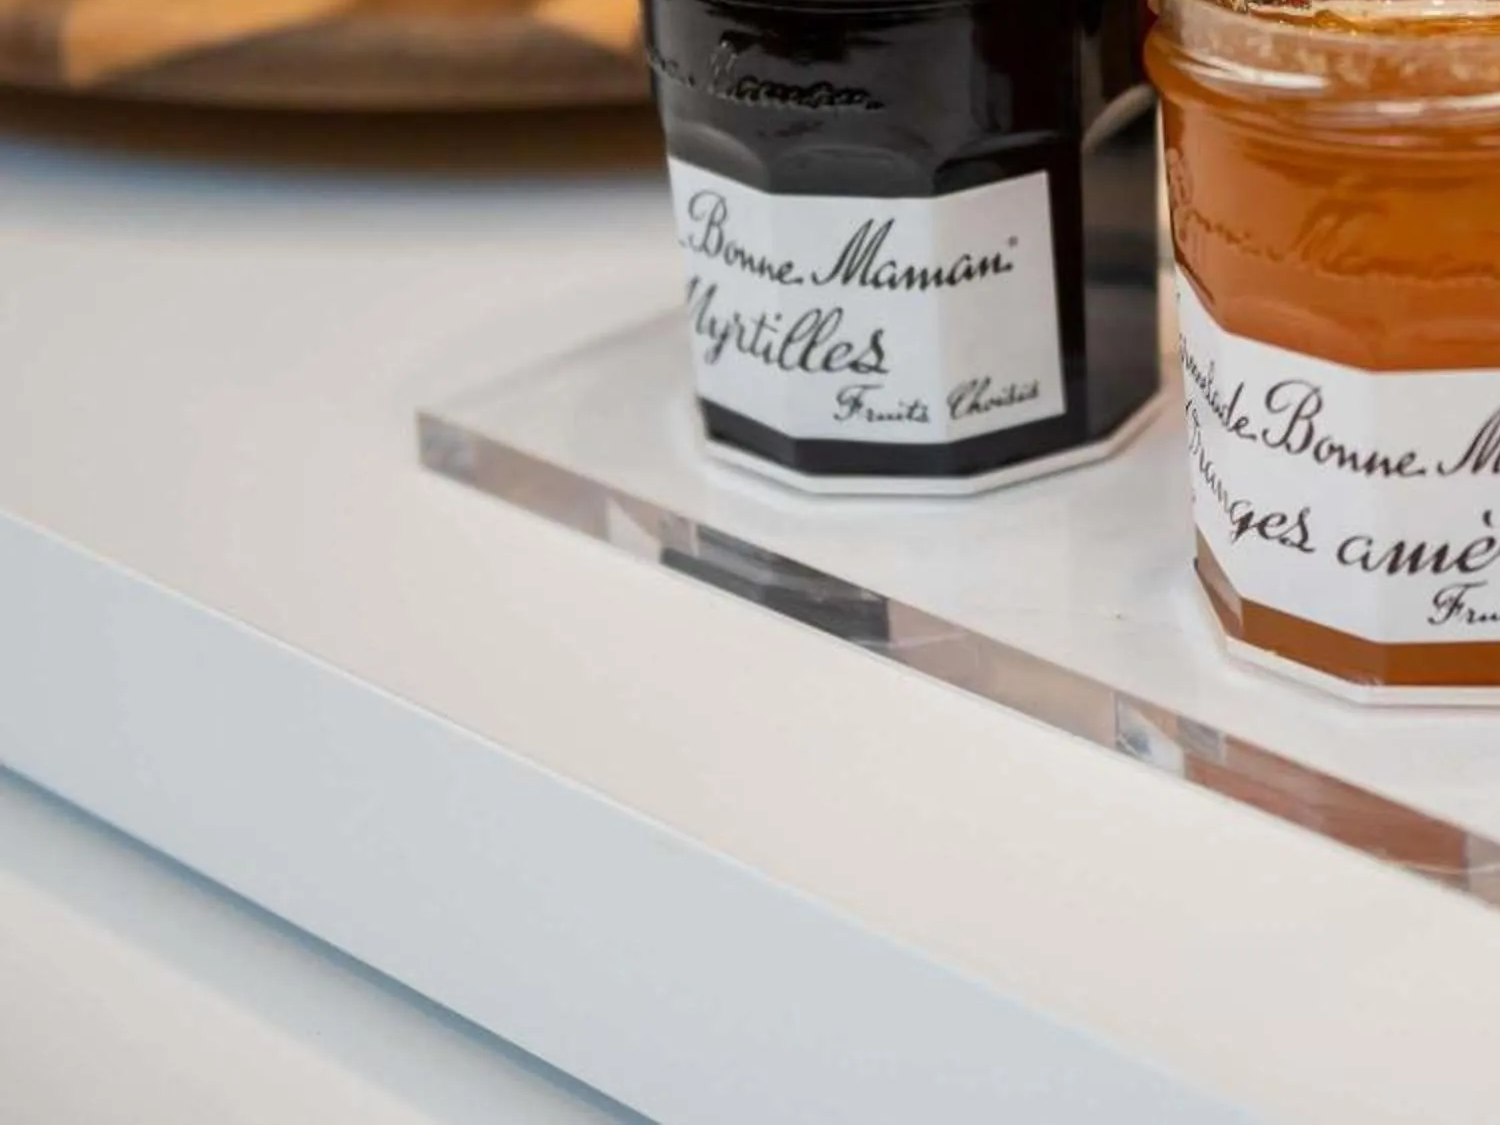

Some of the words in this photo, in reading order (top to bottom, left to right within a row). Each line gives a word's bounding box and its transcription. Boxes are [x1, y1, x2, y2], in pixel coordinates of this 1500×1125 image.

[686, 189, 804, 286] Bonne
[811, 217, 1013, 293] Maman
[832, 383, 931, 425] Fruits
[945, 377, 1040, 421] Choisis
[1261, 379, 1426, 477] Bonne
